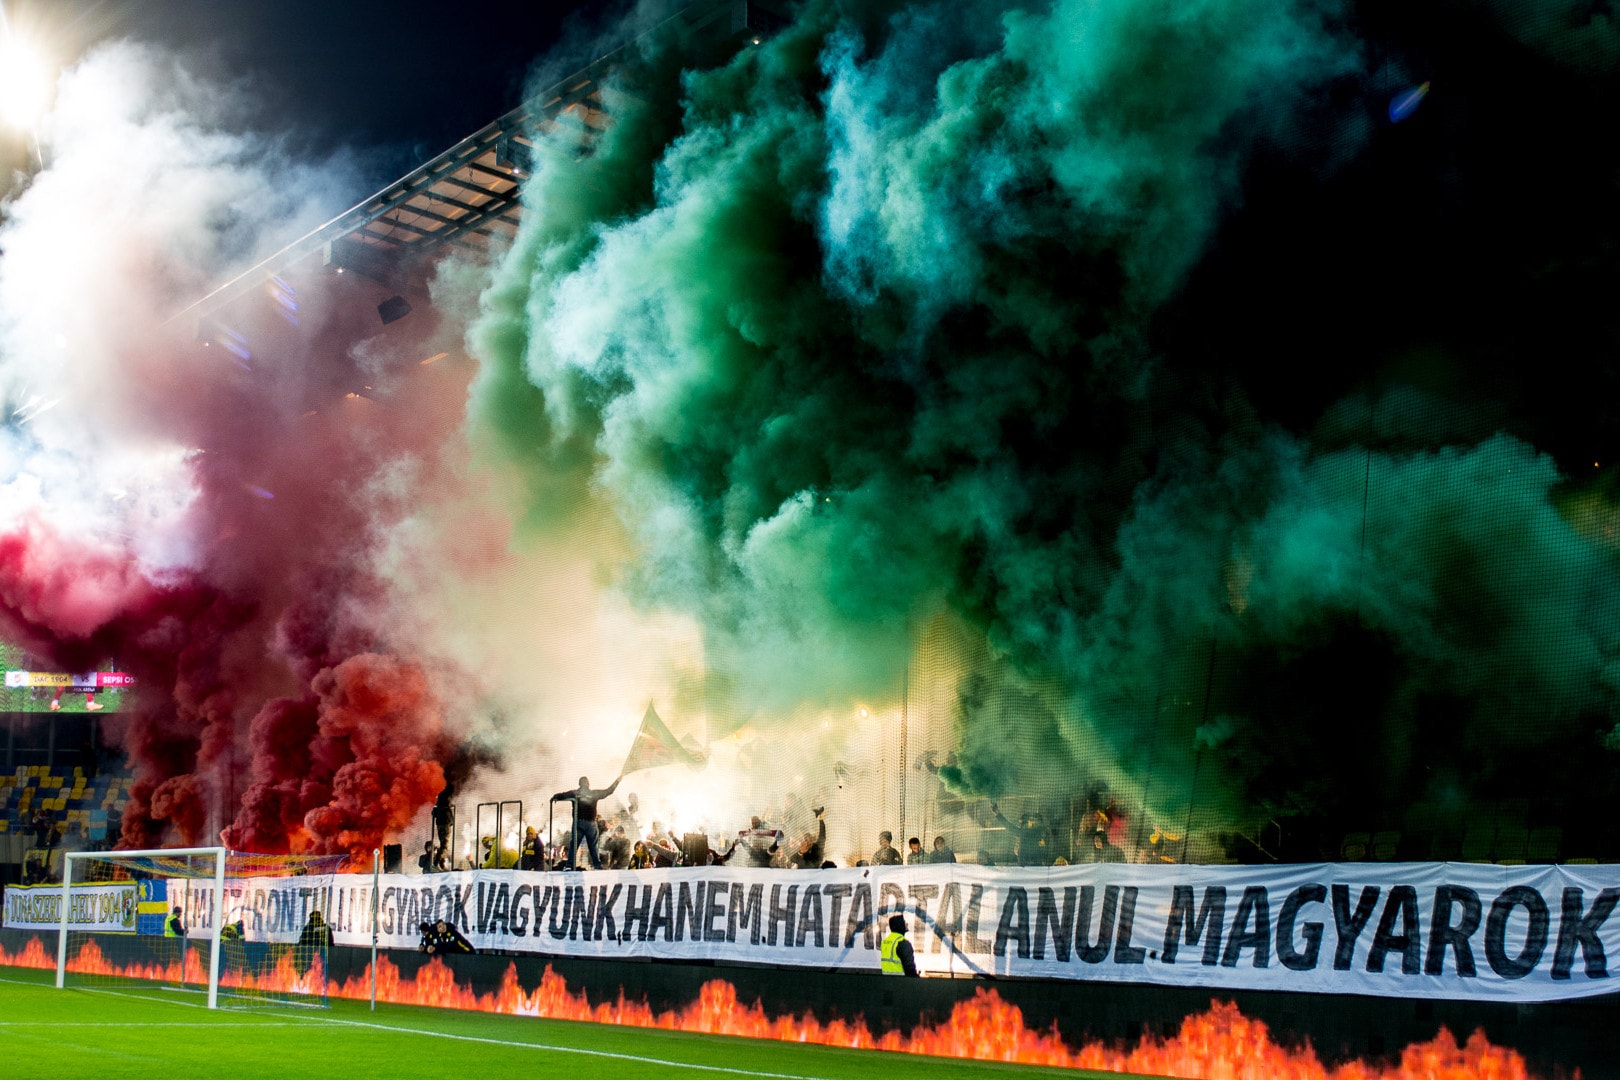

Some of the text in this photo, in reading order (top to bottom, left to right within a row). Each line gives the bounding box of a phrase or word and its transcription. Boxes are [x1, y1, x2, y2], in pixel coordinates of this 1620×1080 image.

[102, 676, 123, 684] SEPSI
[11, 894, 98, 923] DUNASZERDHELY
[1161, 883, 1620, 980] MAGYAROK
